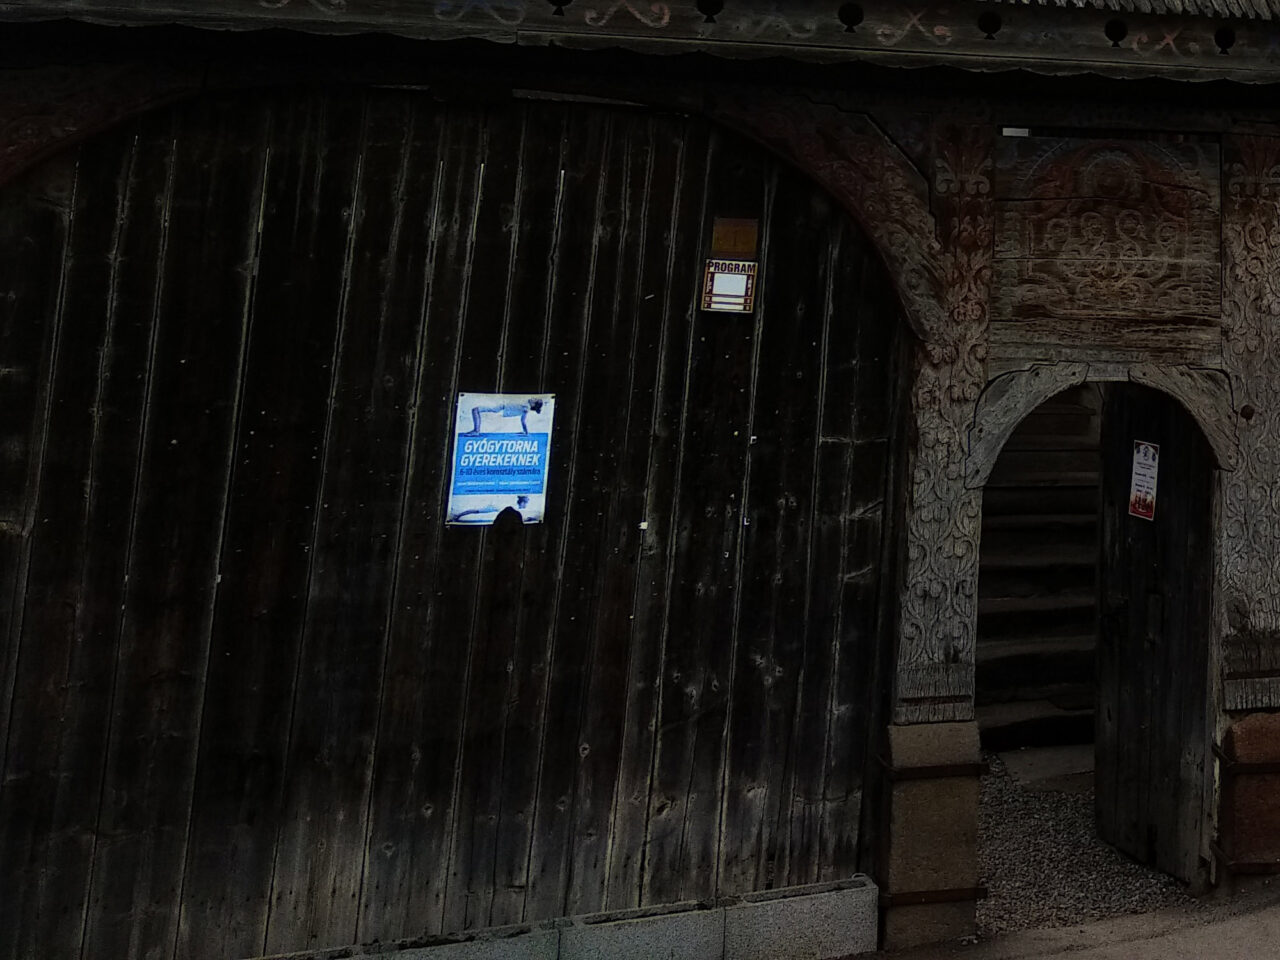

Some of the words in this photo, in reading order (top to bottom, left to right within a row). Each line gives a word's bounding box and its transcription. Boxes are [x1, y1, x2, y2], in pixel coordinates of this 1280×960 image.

[707, 261, 756, 273] PROGRAM
[464, 439, 538, 453] GYÓGYTORNA
[460, 454, 541, 466] GYEREKEKNEK
